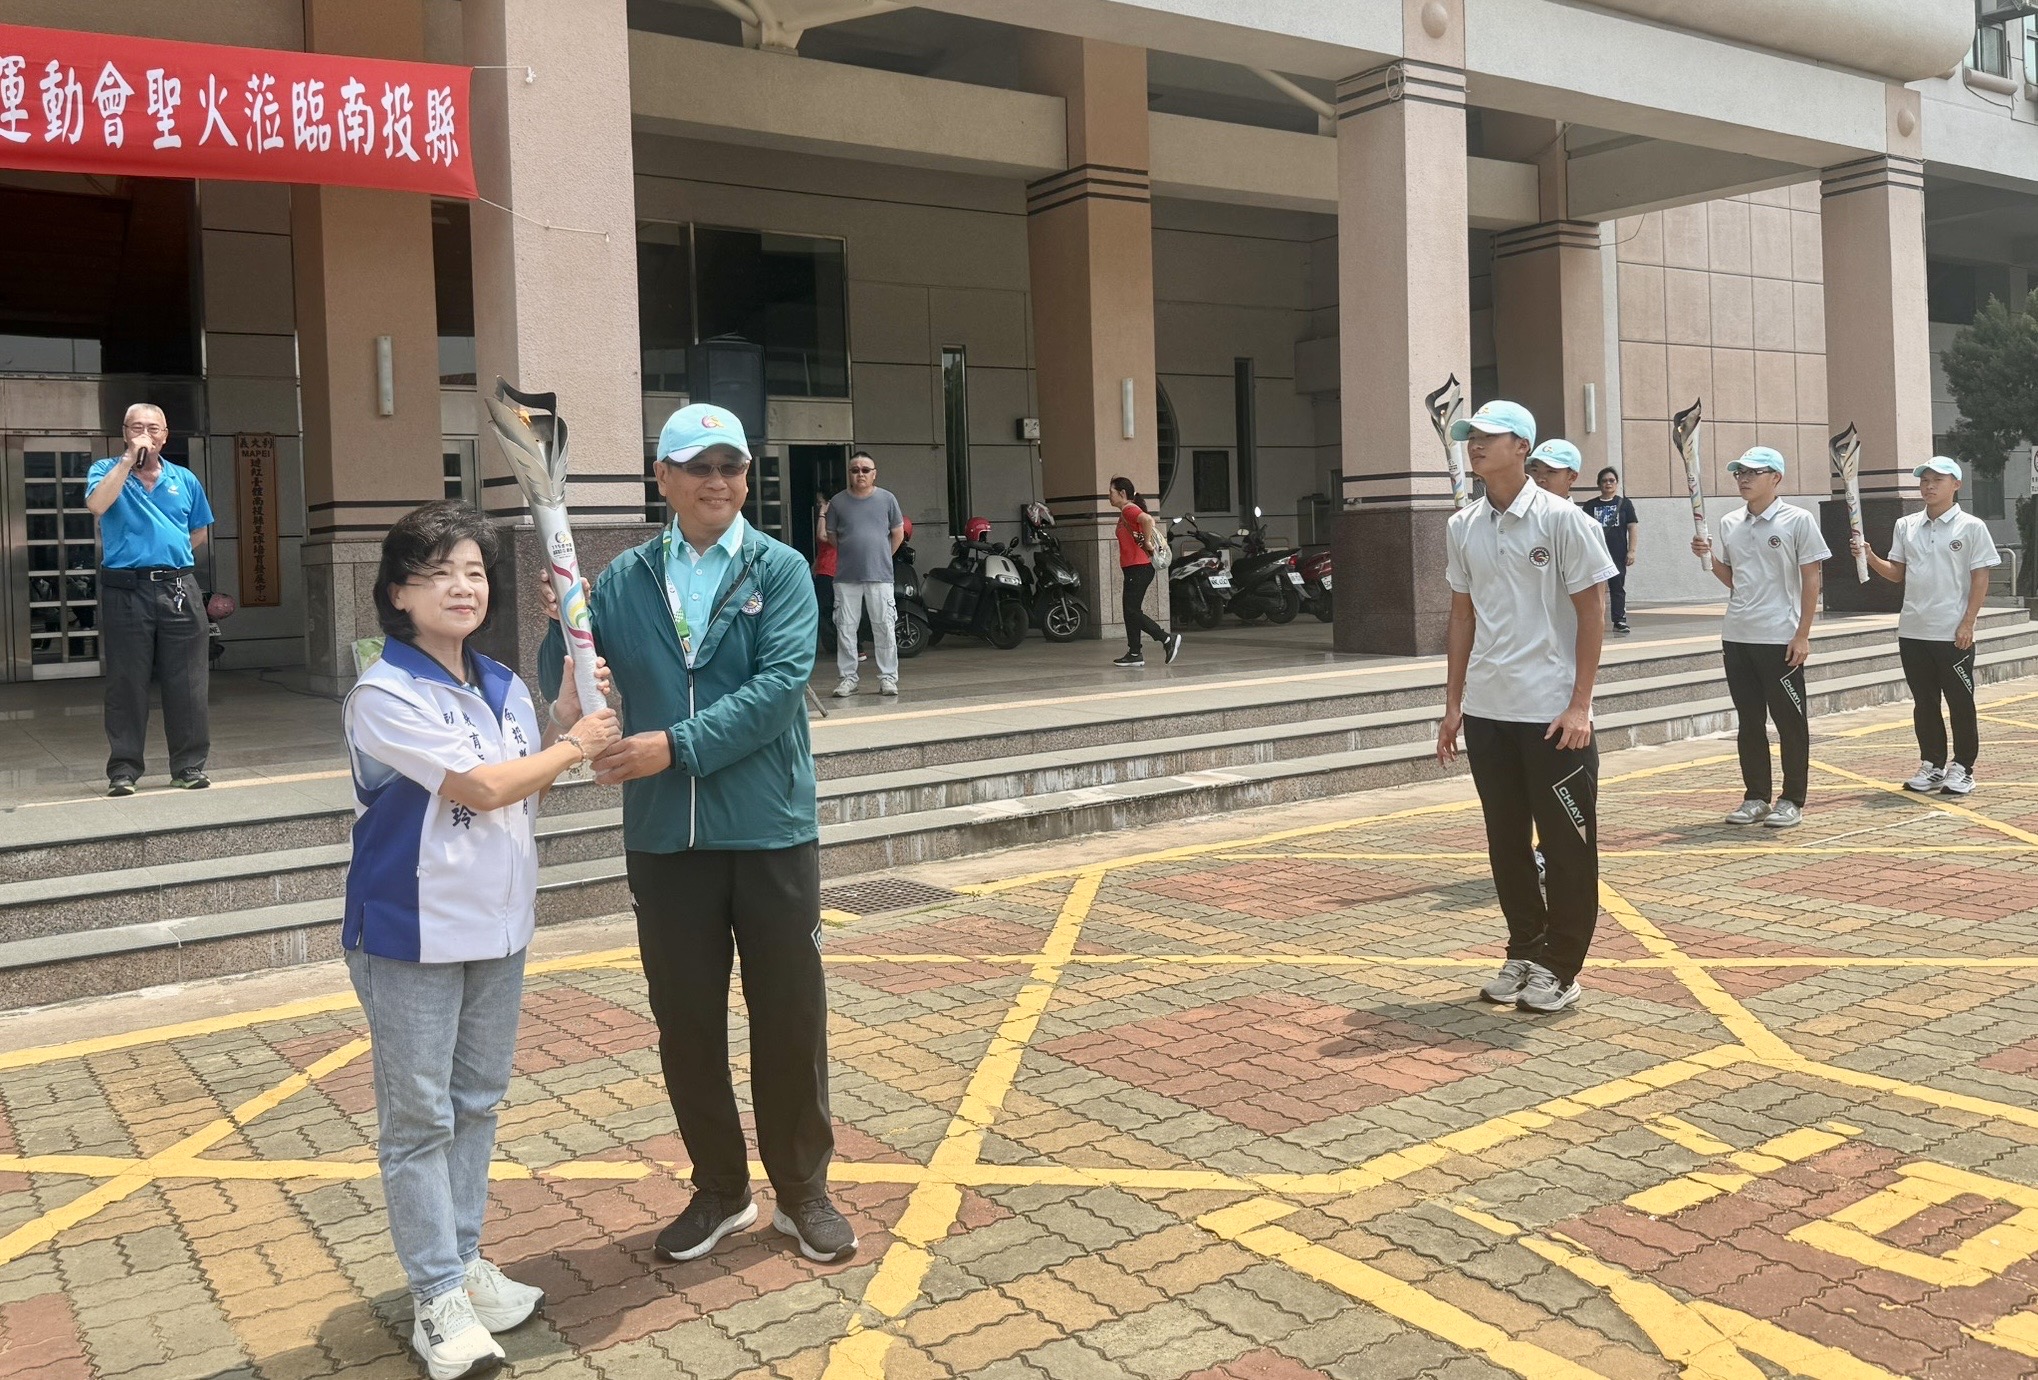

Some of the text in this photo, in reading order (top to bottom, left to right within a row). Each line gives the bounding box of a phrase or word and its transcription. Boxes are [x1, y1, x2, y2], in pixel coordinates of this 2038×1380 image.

[241, 449, 271, 457] MAPEI
[1783, 679, 1801, 704] CHIAYI
[450, 800, 477, 830] 玲
[1558, 786, 1585, 824] CHIAYI
